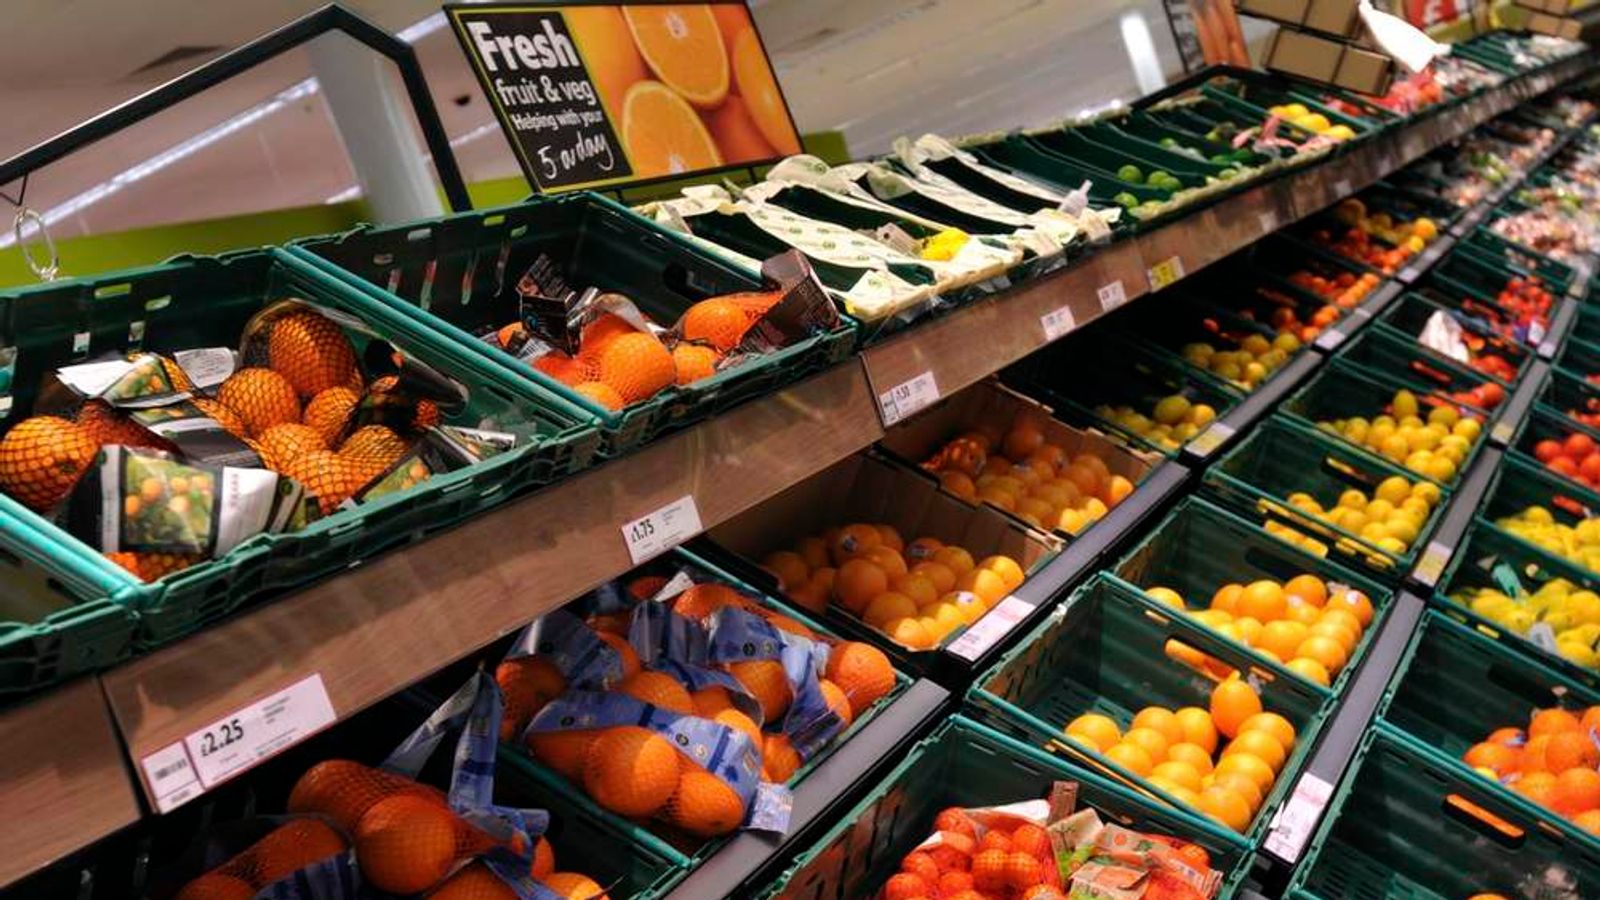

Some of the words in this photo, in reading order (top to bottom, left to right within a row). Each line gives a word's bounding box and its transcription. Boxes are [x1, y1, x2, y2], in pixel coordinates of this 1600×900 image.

[466, 19, 579, 71] Fresh
[495, 78, 544, 106] fruit
[540, 75, 562, 103] &
[559, 80, 597, 106] veg
[511, 112, 558, 132] Helping
[556, 109, 582, 126] with
[579, 110, 603, 128] your
[538, 145, 557, 179] 5
[200, 719, 245, 757] £2.25
